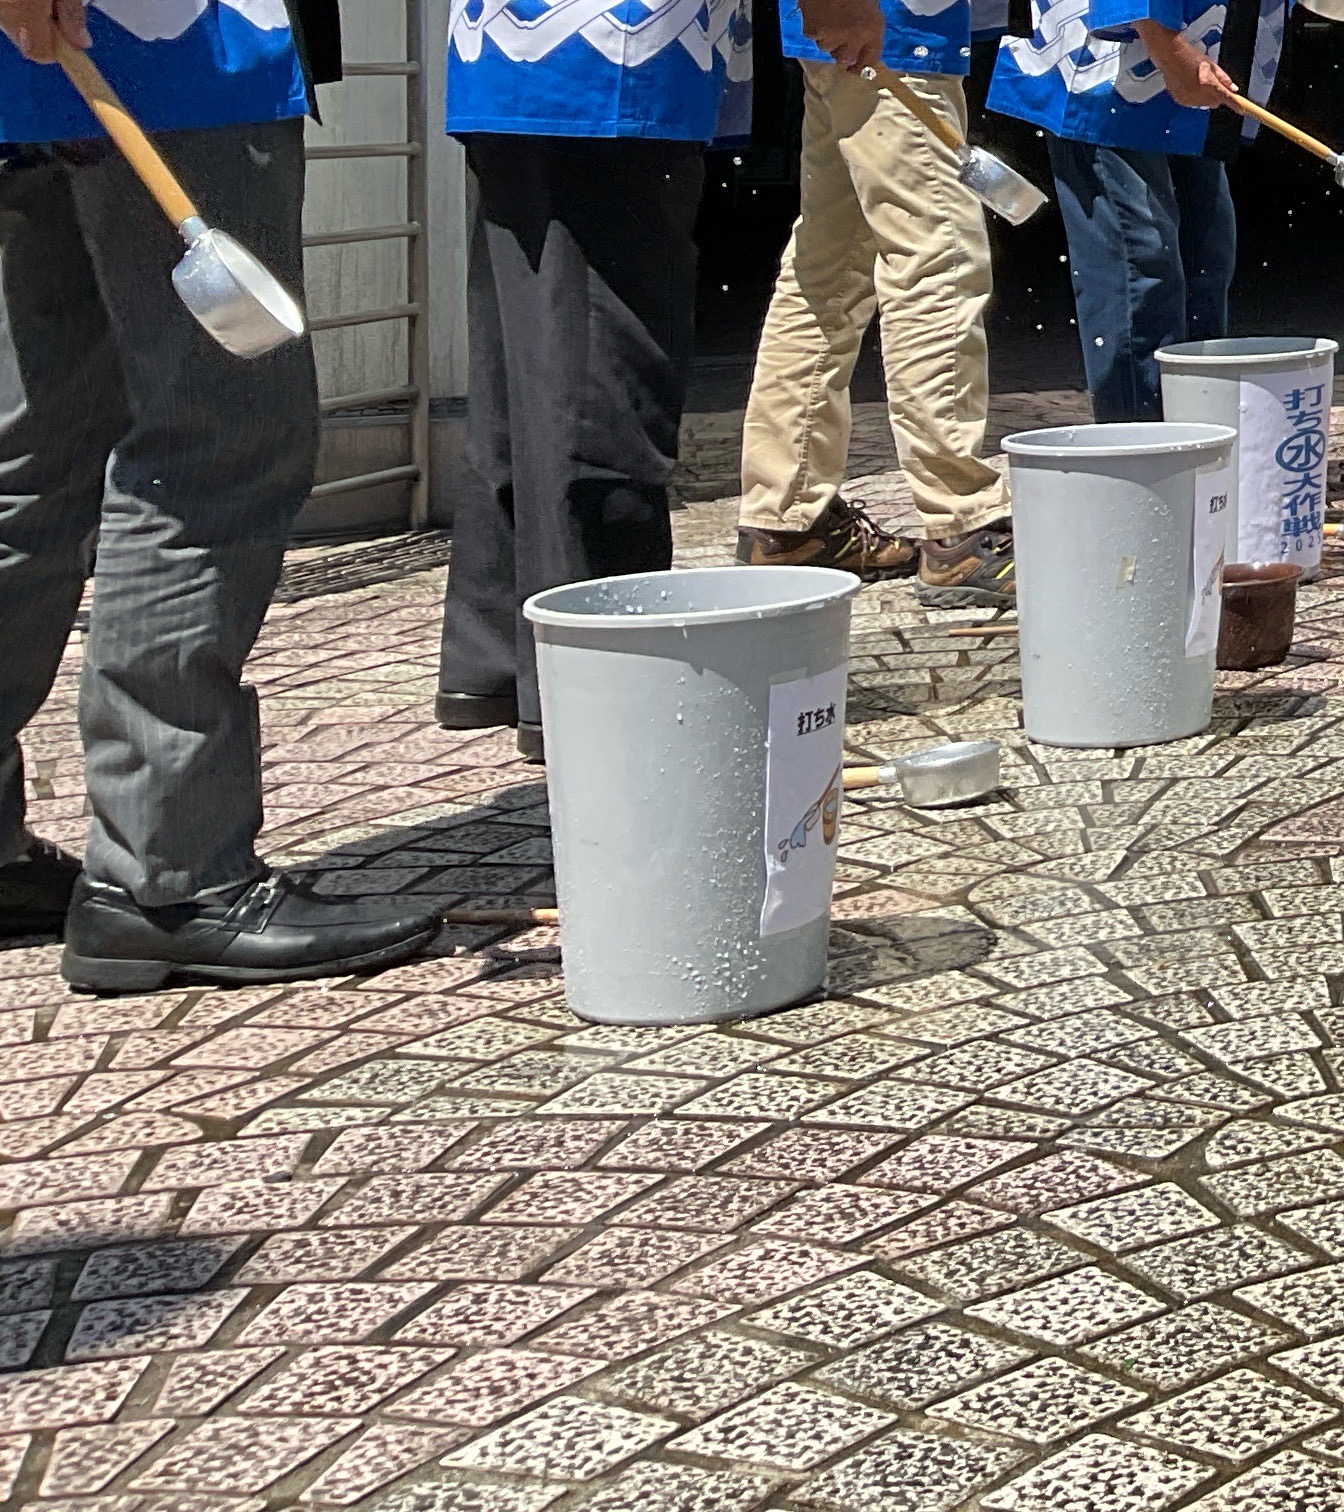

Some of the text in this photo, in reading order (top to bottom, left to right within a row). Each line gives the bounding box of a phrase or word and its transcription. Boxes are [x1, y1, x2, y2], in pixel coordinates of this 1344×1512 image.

[1275, 383, 1326, 537] 打ち水大作戦
[797, 701, 837, 736] 打ち水
